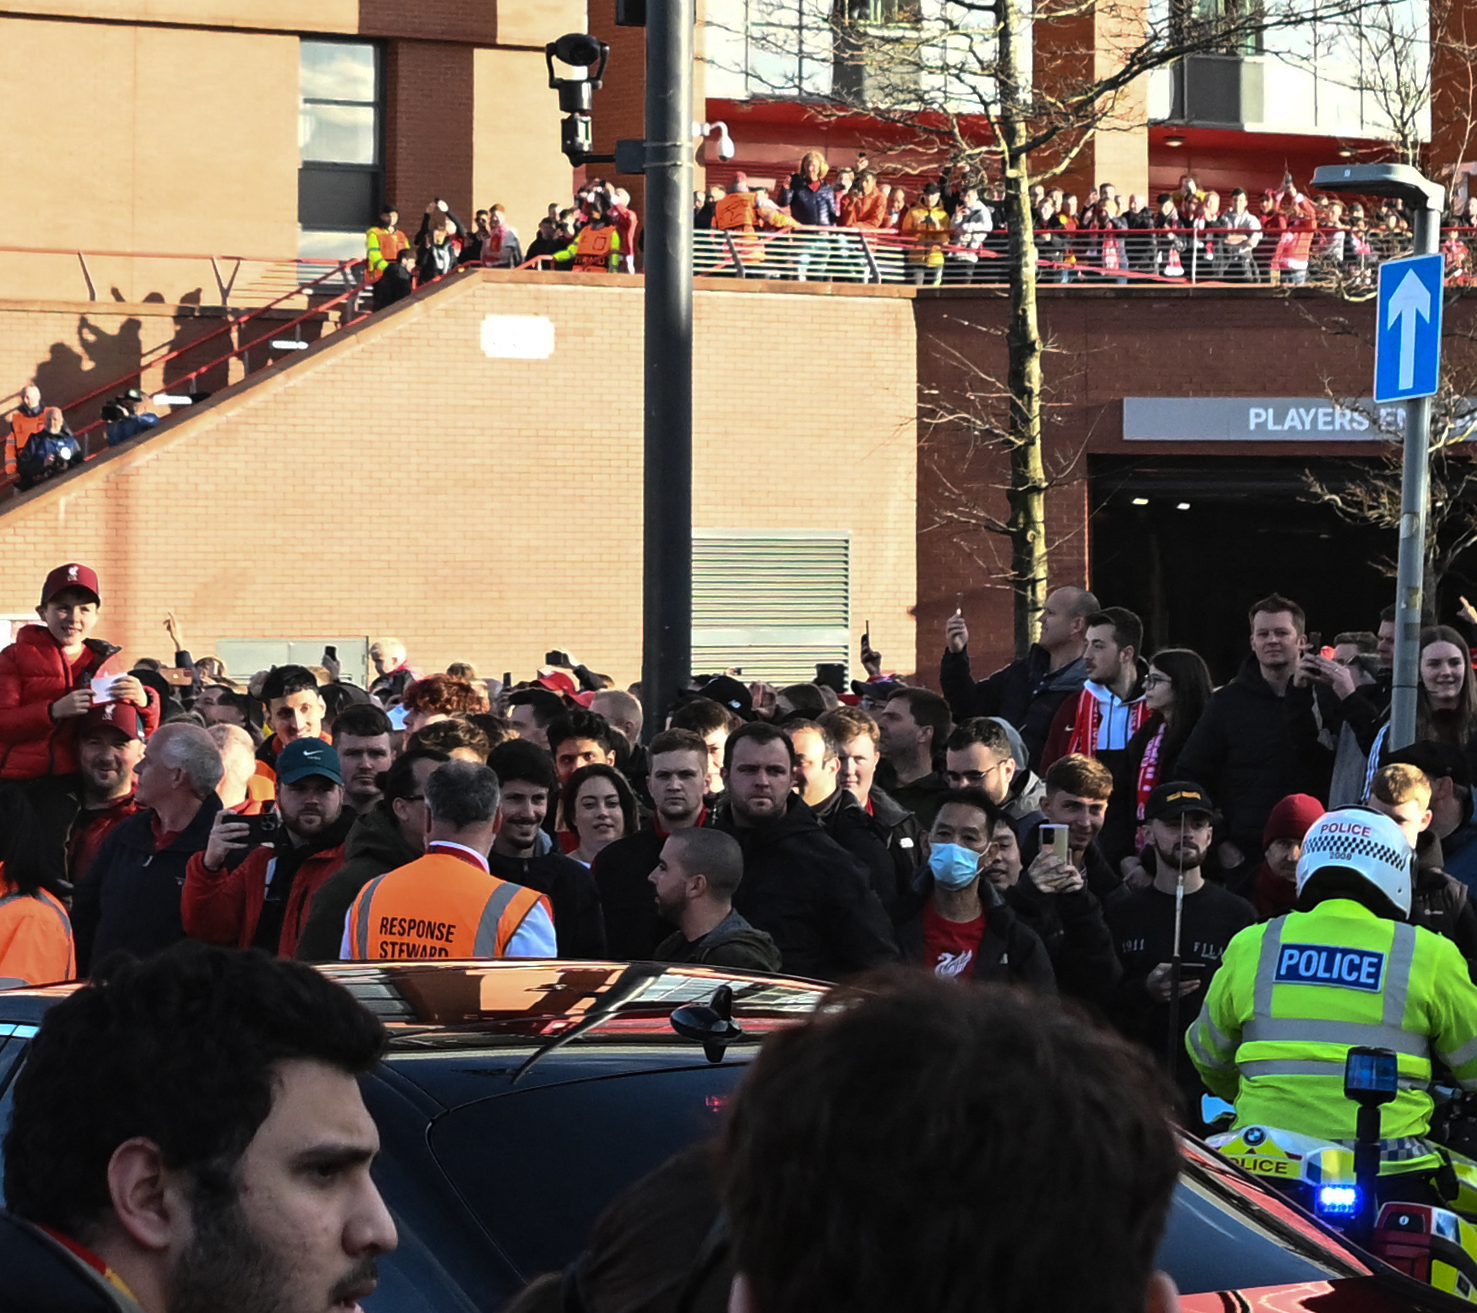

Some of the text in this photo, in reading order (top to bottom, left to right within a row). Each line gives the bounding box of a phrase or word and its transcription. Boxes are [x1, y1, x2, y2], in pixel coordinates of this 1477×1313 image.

[1249, 407, 1370, 432] PLAYERS
[1320, 822, 1372, 839] POLICE
[379, 916, 457, 944] RESPONSE
[1279, 948, 1379, 985] POLICE
